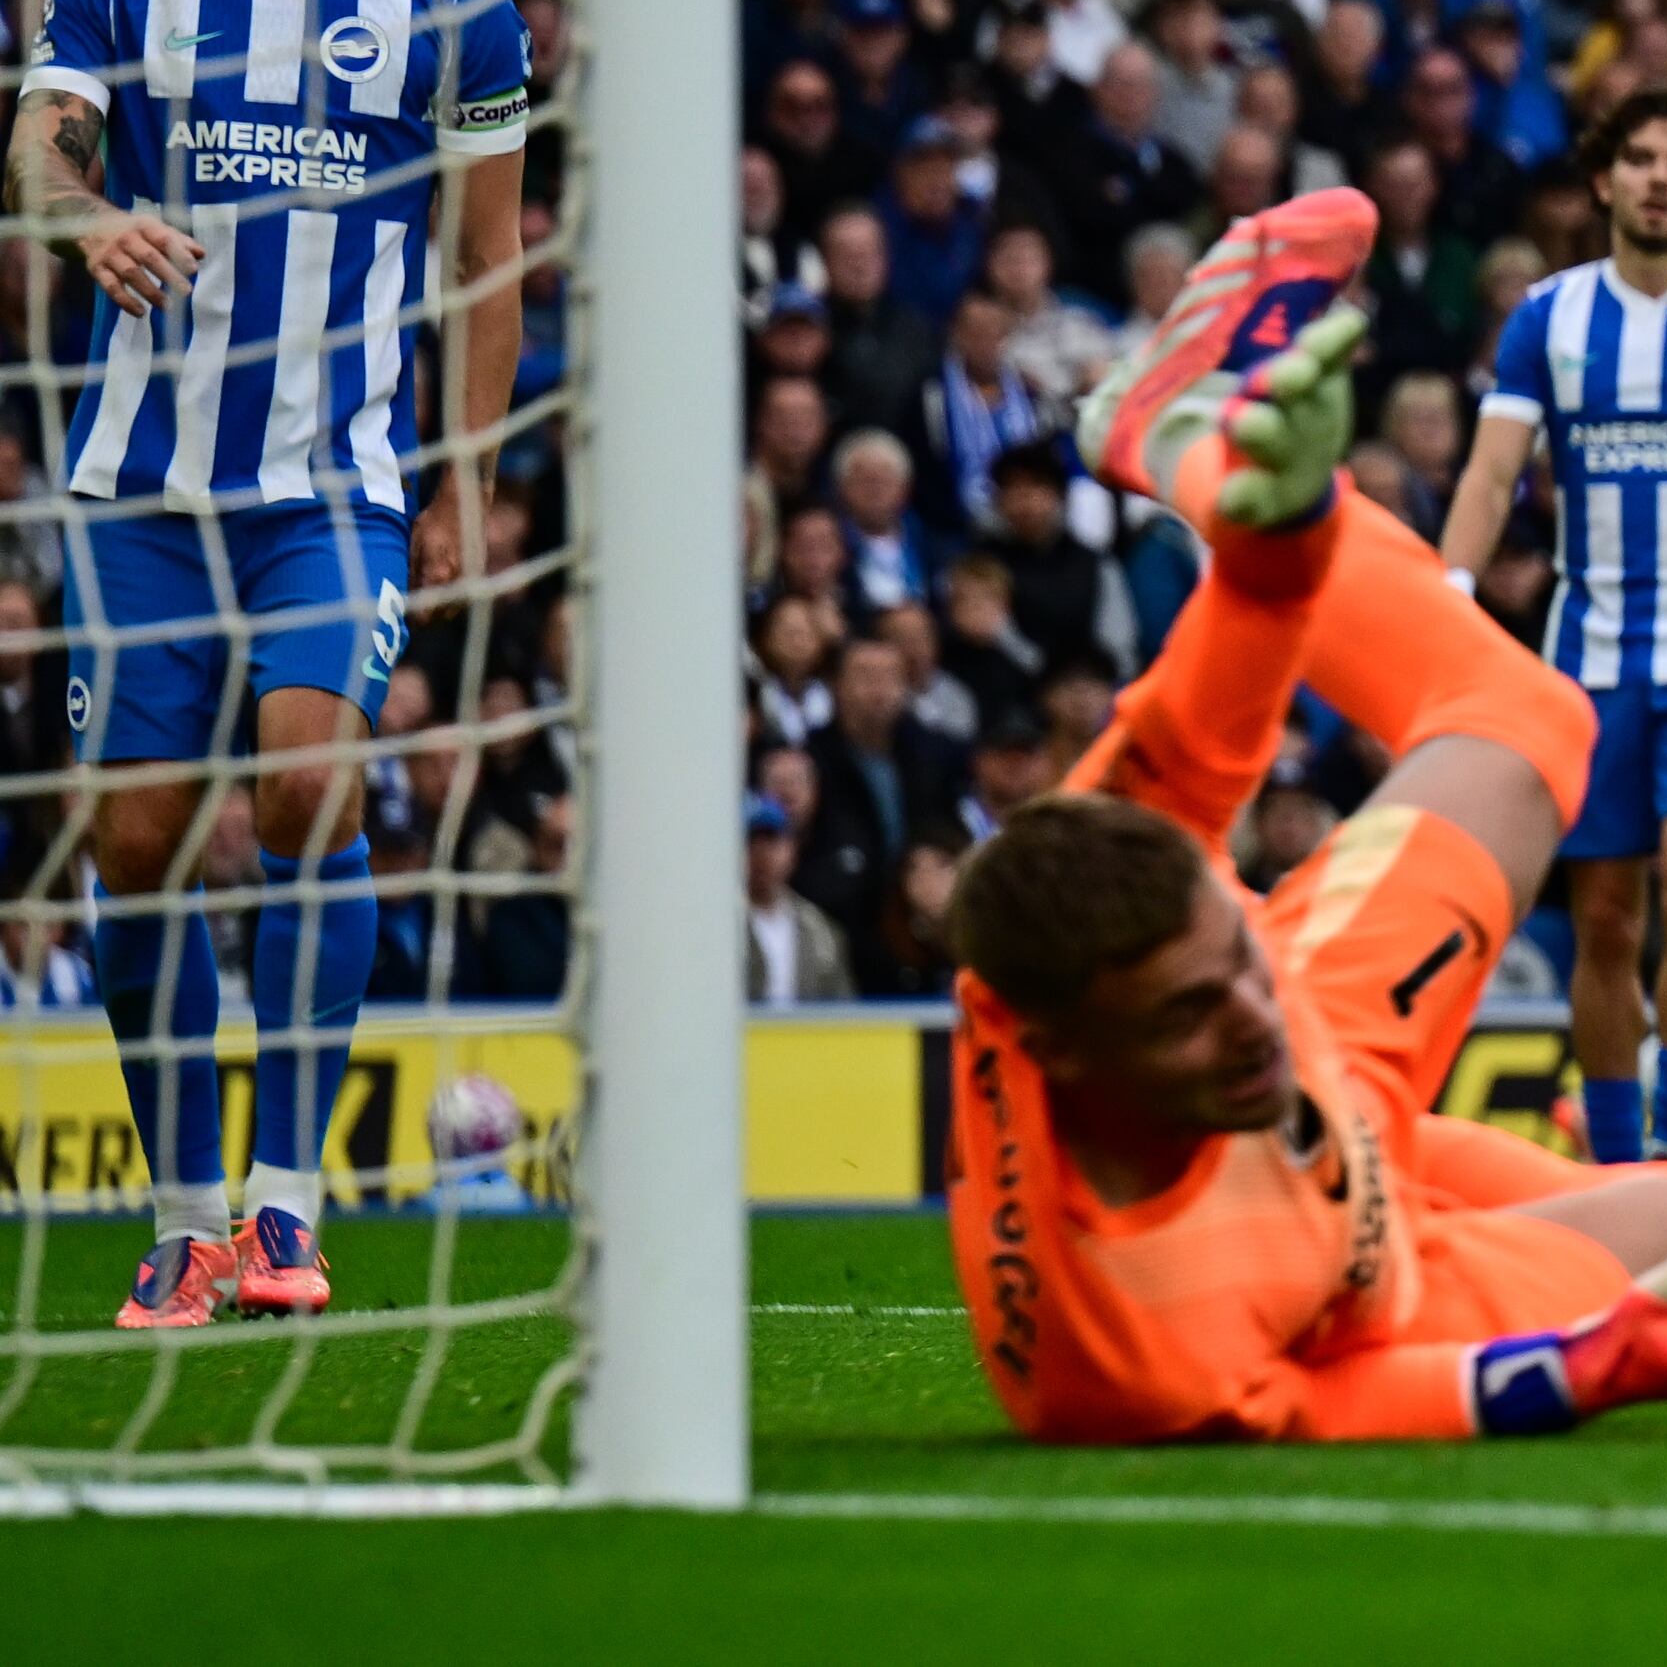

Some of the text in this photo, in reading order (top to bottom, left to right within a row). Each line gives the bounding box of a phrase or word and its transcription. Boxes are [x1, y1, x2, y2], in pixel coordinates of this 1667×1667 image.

[468, 98, 528, 123] Capta
[166, 120, 368, 162] AMERICAN
[195, 152, 367, 195] EXPRESS
